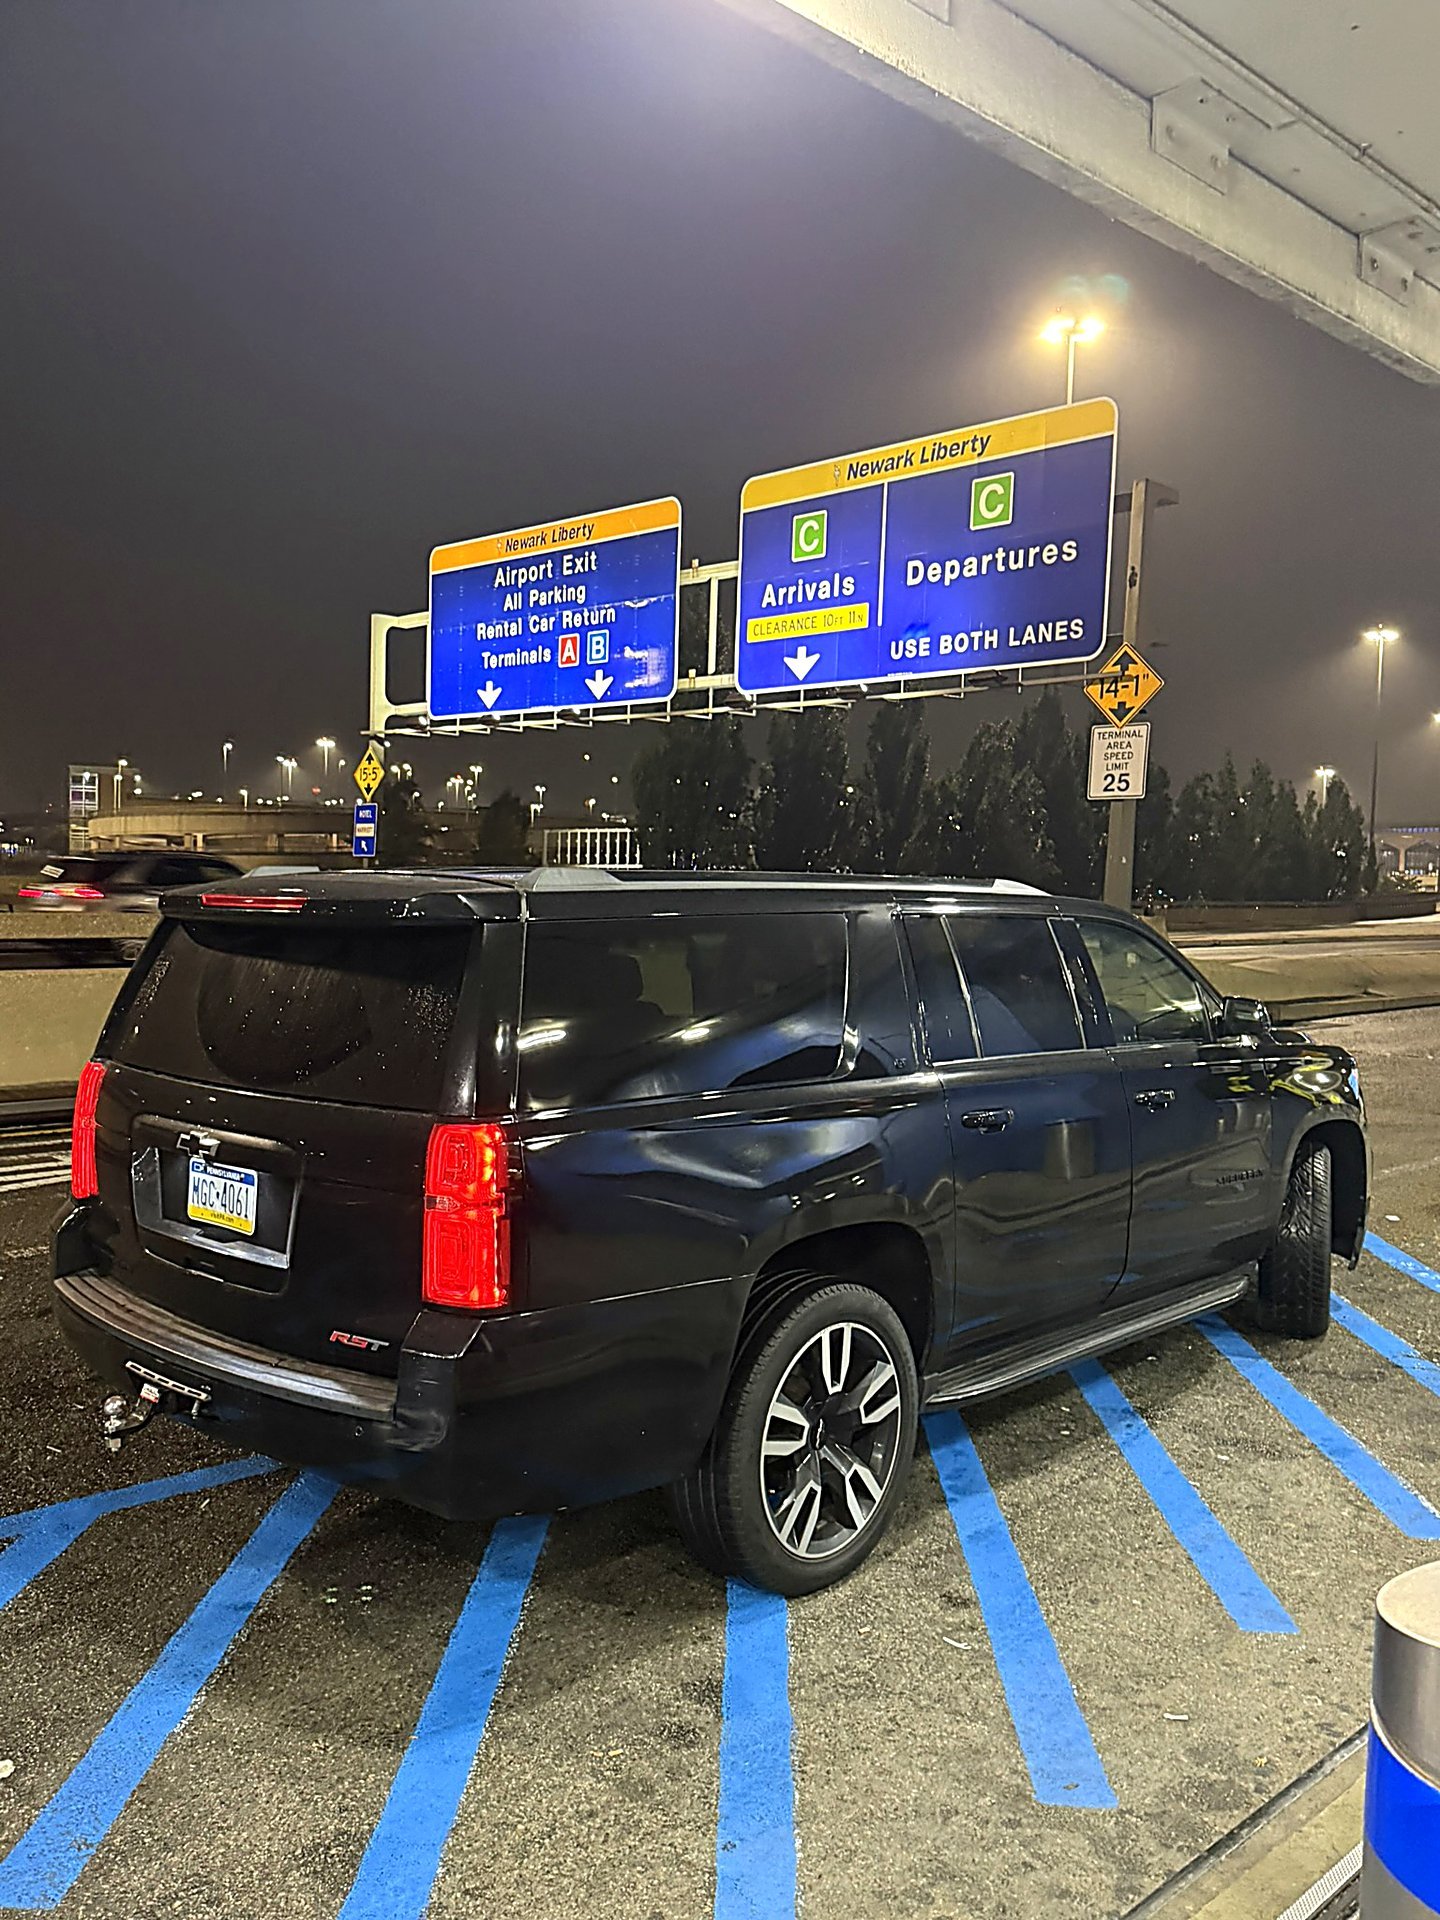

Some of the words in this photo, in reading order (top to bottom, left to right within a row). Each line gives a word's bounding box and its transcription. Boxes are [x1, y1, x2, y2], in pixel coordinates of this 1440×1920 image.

[847, 449, 915, 481] Newark
[920, 433, 992, 464] Liberty
[978, 482, 1004, 519] C
[505, 531, 547, 553] Newark
[551, 523, 595, 543] Liberty
[798, 519, 820, 552] C
[494, 560, 553, 588] Airport
[562, 551, 597, 575] Exit
[906, 540, 1077, 587] Departures
[503, 591, 522, 612] All
[529, 584, 586, 608] Parking
[761, 572, 855, 608] Arrivals
[476, 618, 522, 641] Rental
[529, 615, 554, 634] Car
[563, 608, 616, 629] Return
[753, 616, 818, 636] CLEARANCE
[890, 636, 930, 660] USE
[939, 629, 998, 655] BOTH
[1008, 618, 1084, 647] LANES
[482, 645, 552, 670] Terminals
[562, 640, 576, 662] A
[591, 633, 605, 657] B
[1097, 730, 1143, 740] TERMINAL
[1106, 741, 1132, 750] AREA
[1103, 751, 1134, 761] SPEED
[1105, 762, 1129, 771] LIMIT
[1103, 773, 1130, 792] 25
[329, 1330, 390, 1351] RST
